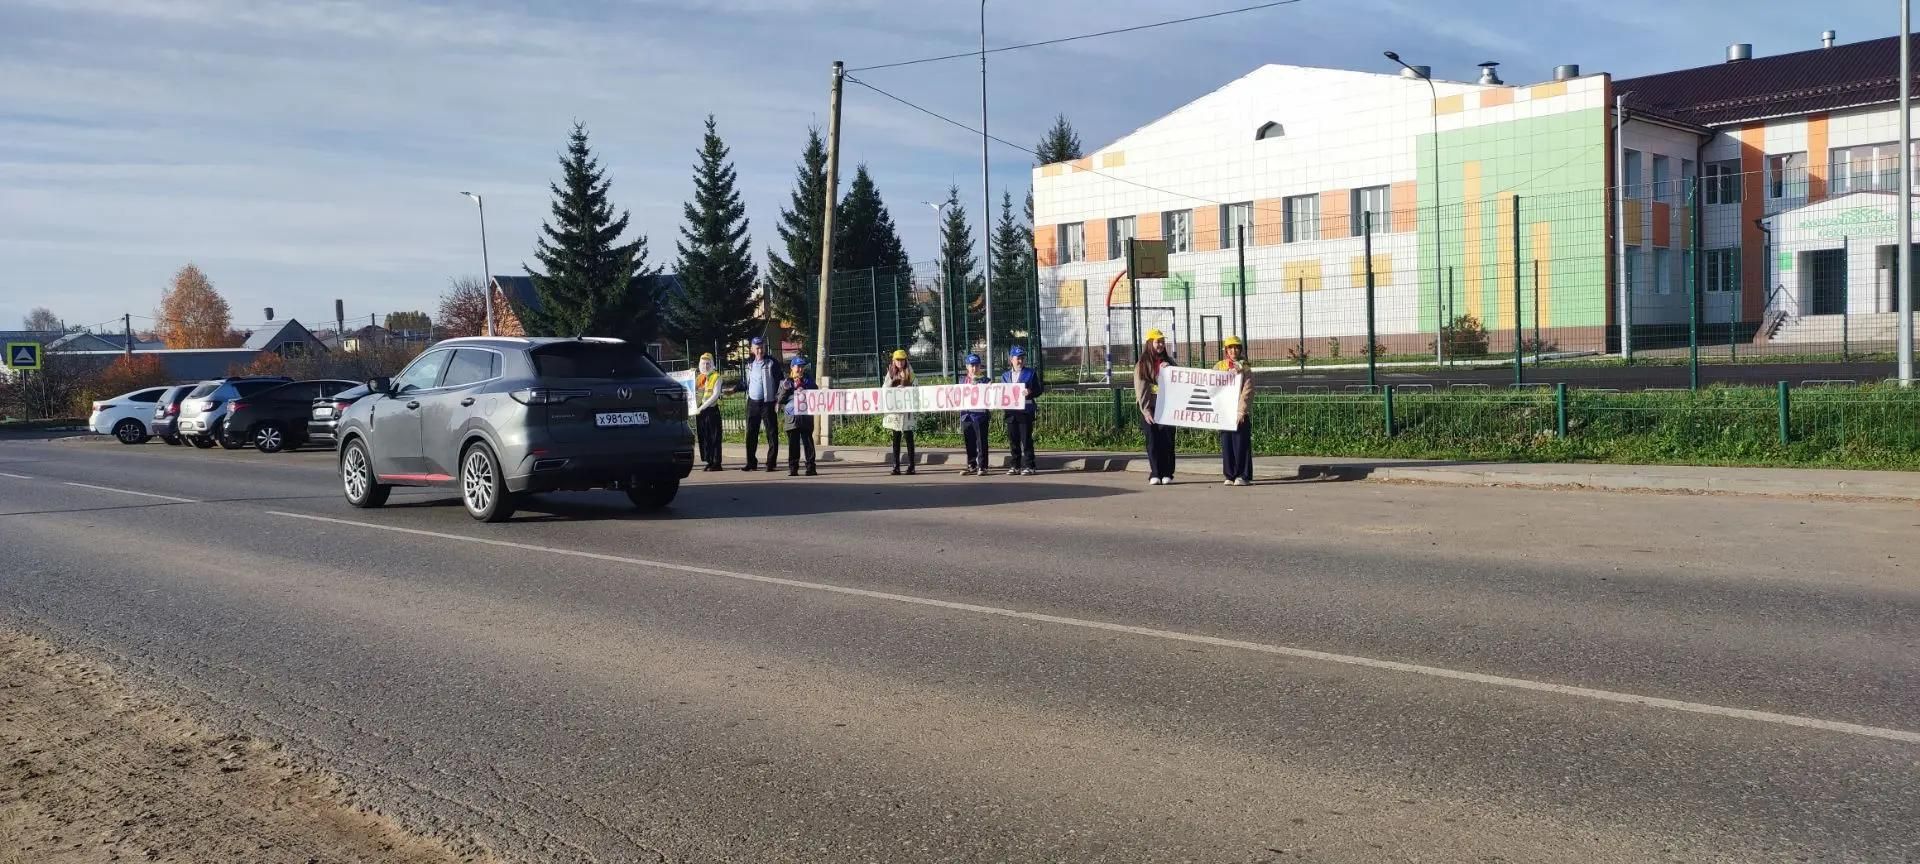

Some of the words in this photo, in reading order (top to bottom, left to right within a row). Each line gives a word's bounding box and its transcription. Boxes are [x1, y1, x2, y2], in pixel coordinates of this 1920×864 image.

[1171, 370, 1236, 386] БЕЗОПАСНЫЙ
[797, 390, 879, 412] ВОДИТЕЛЬ!
[885, 387, 930, 411] СБАВЬ
[1173, 409, 1220, 423] ПЕРЕХОД
